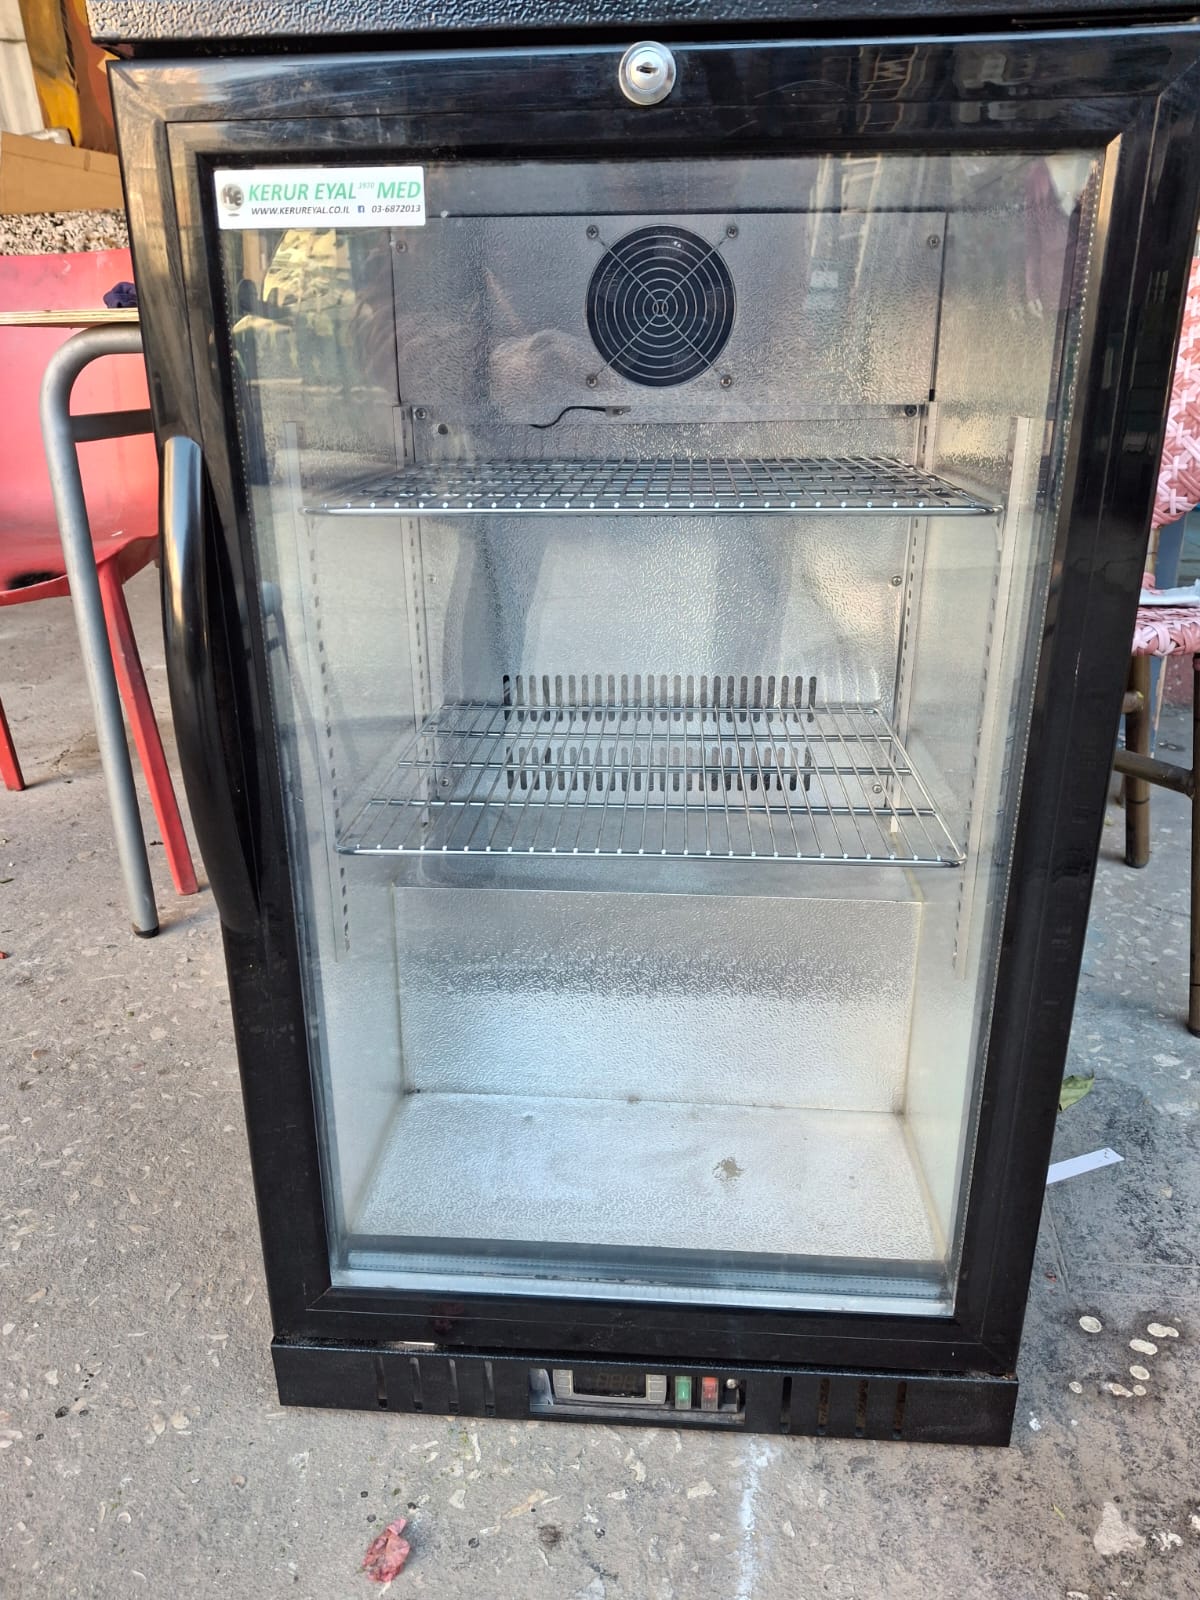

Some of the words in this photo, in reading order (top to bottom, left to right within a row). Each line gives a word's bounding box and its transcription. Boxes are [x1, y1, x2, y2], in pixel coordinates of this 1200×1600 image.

[248, 183, 309, 201] KERUR
[314, 182, 357, 200] EYAL
[377, 181, 421, 199] MED
[251, 206, 350, 215] WWW.KERUREYAL.CO.IL
[371, 204, 421, 213] 03-6872013
